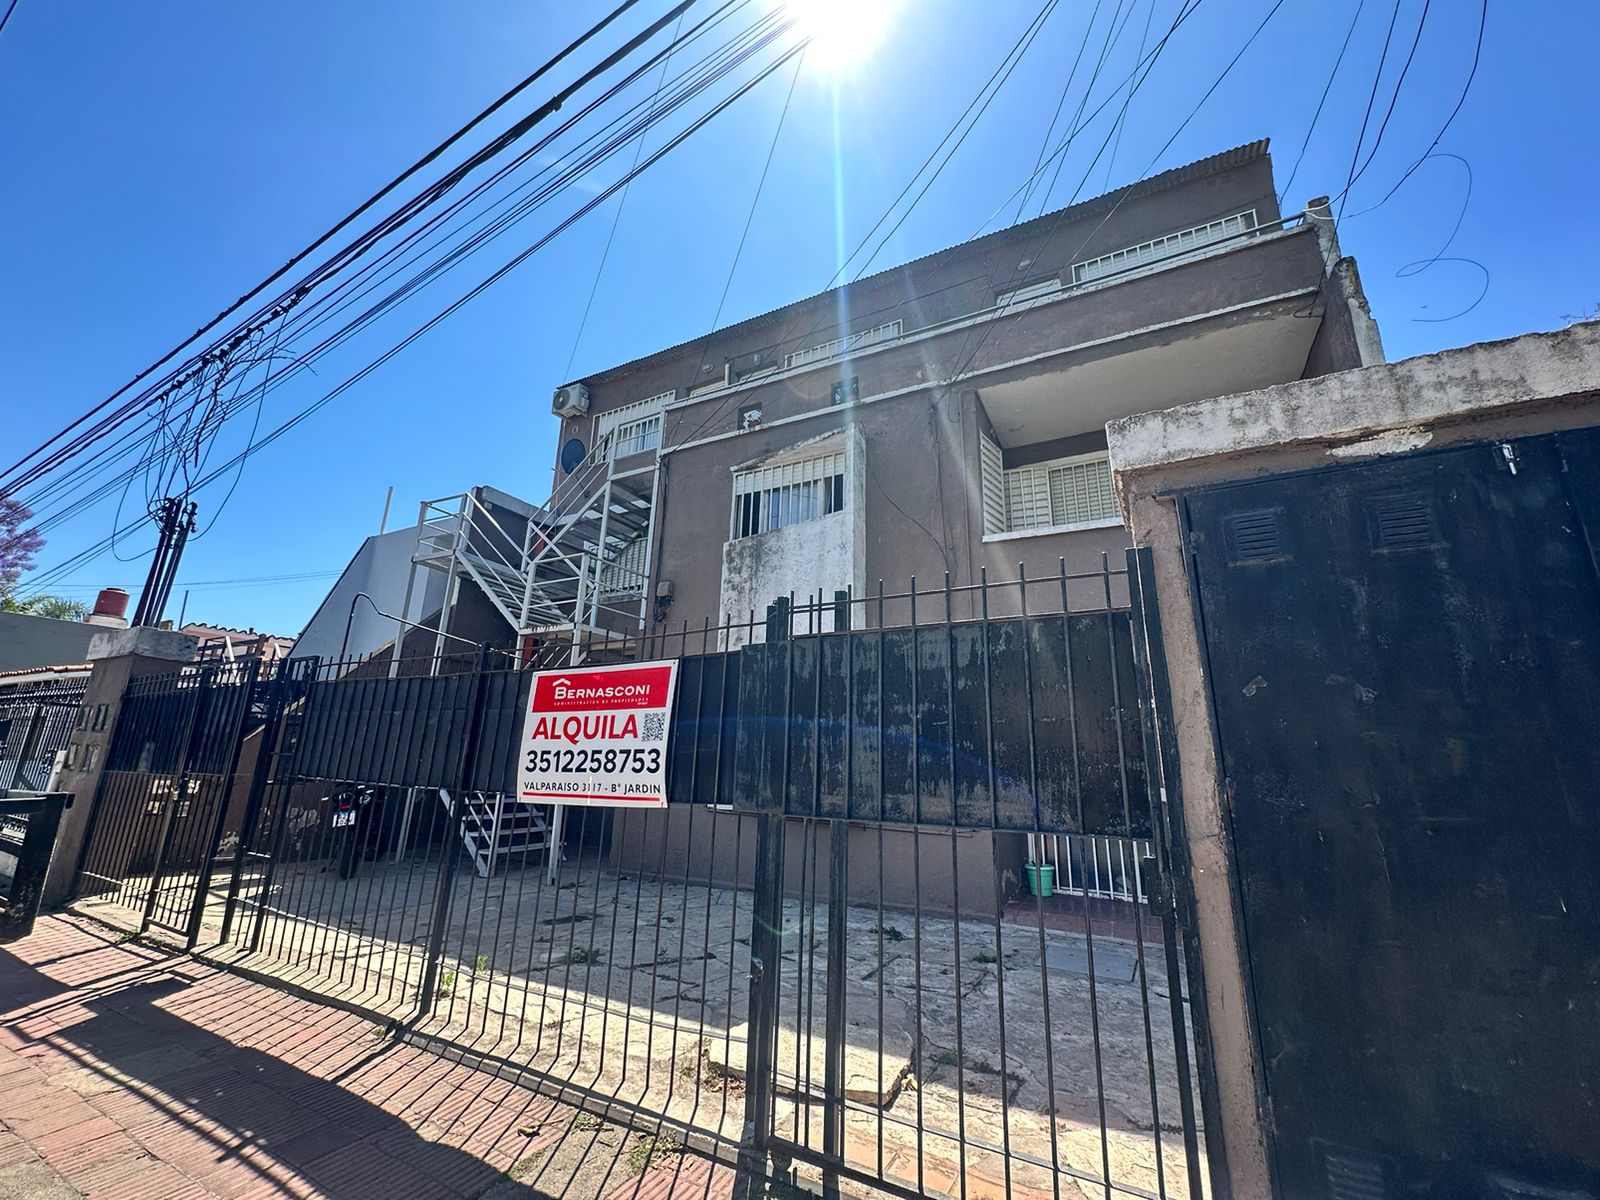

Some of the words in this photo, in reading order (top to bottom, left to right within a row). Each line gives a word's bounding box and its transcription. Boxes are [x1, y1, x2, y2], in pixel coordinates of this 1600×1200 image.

[553, 684, 650, 700] BERNASCONI
[531, 713, 639, 746] ALQUILA
[525, 748, 661, 774] 3512258753
[524, 781, 579, 792] VALPARAISO
[581, 783, 602, 793] 3117
[623, 784, 661, 795] JARDIN
